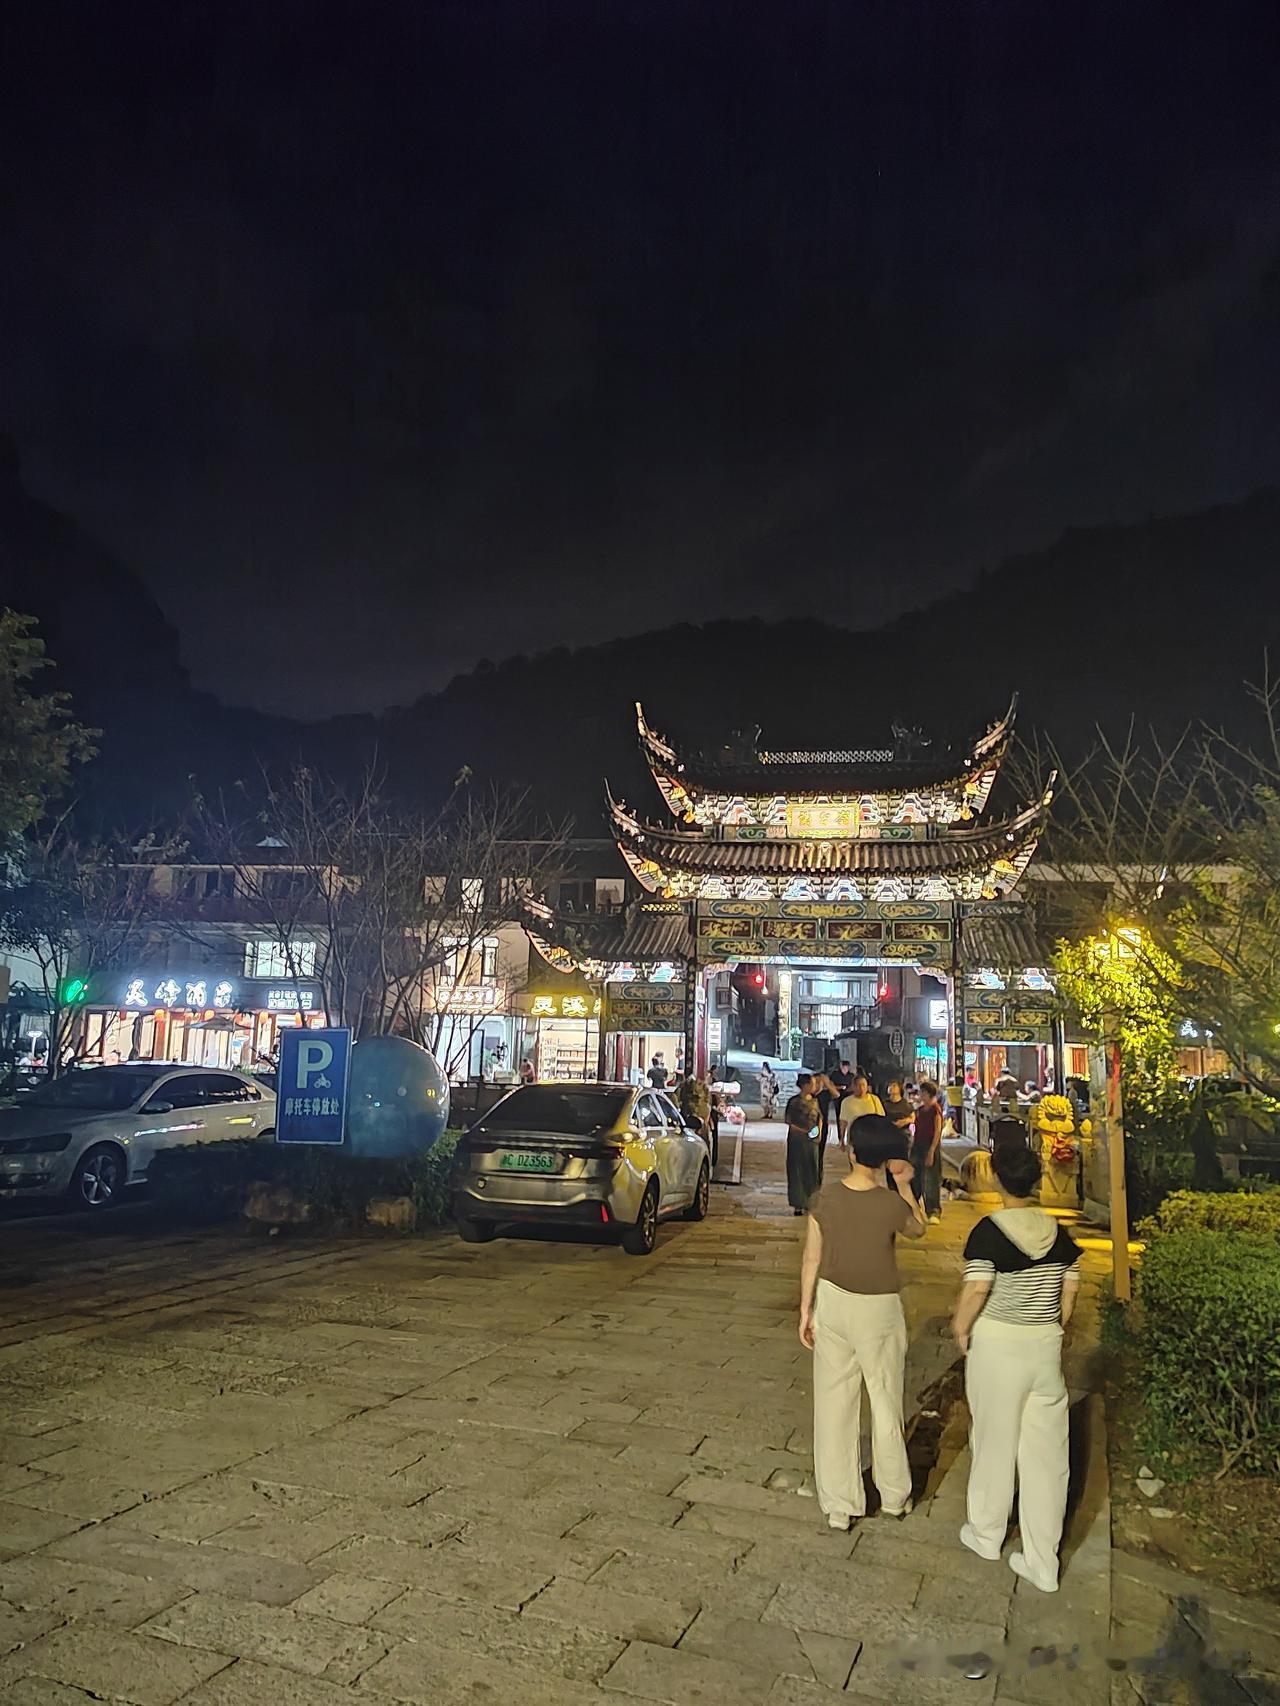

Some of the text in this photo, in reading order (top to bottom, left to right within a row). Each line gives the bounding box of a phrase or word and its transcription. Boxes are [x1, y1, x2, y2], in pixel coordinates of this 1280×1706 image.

[531, 995, 601, 1017] 灵溪
[296, 1040, 333, 1088] P
[285, 1097, 339, 1116] 摩托车停放处
